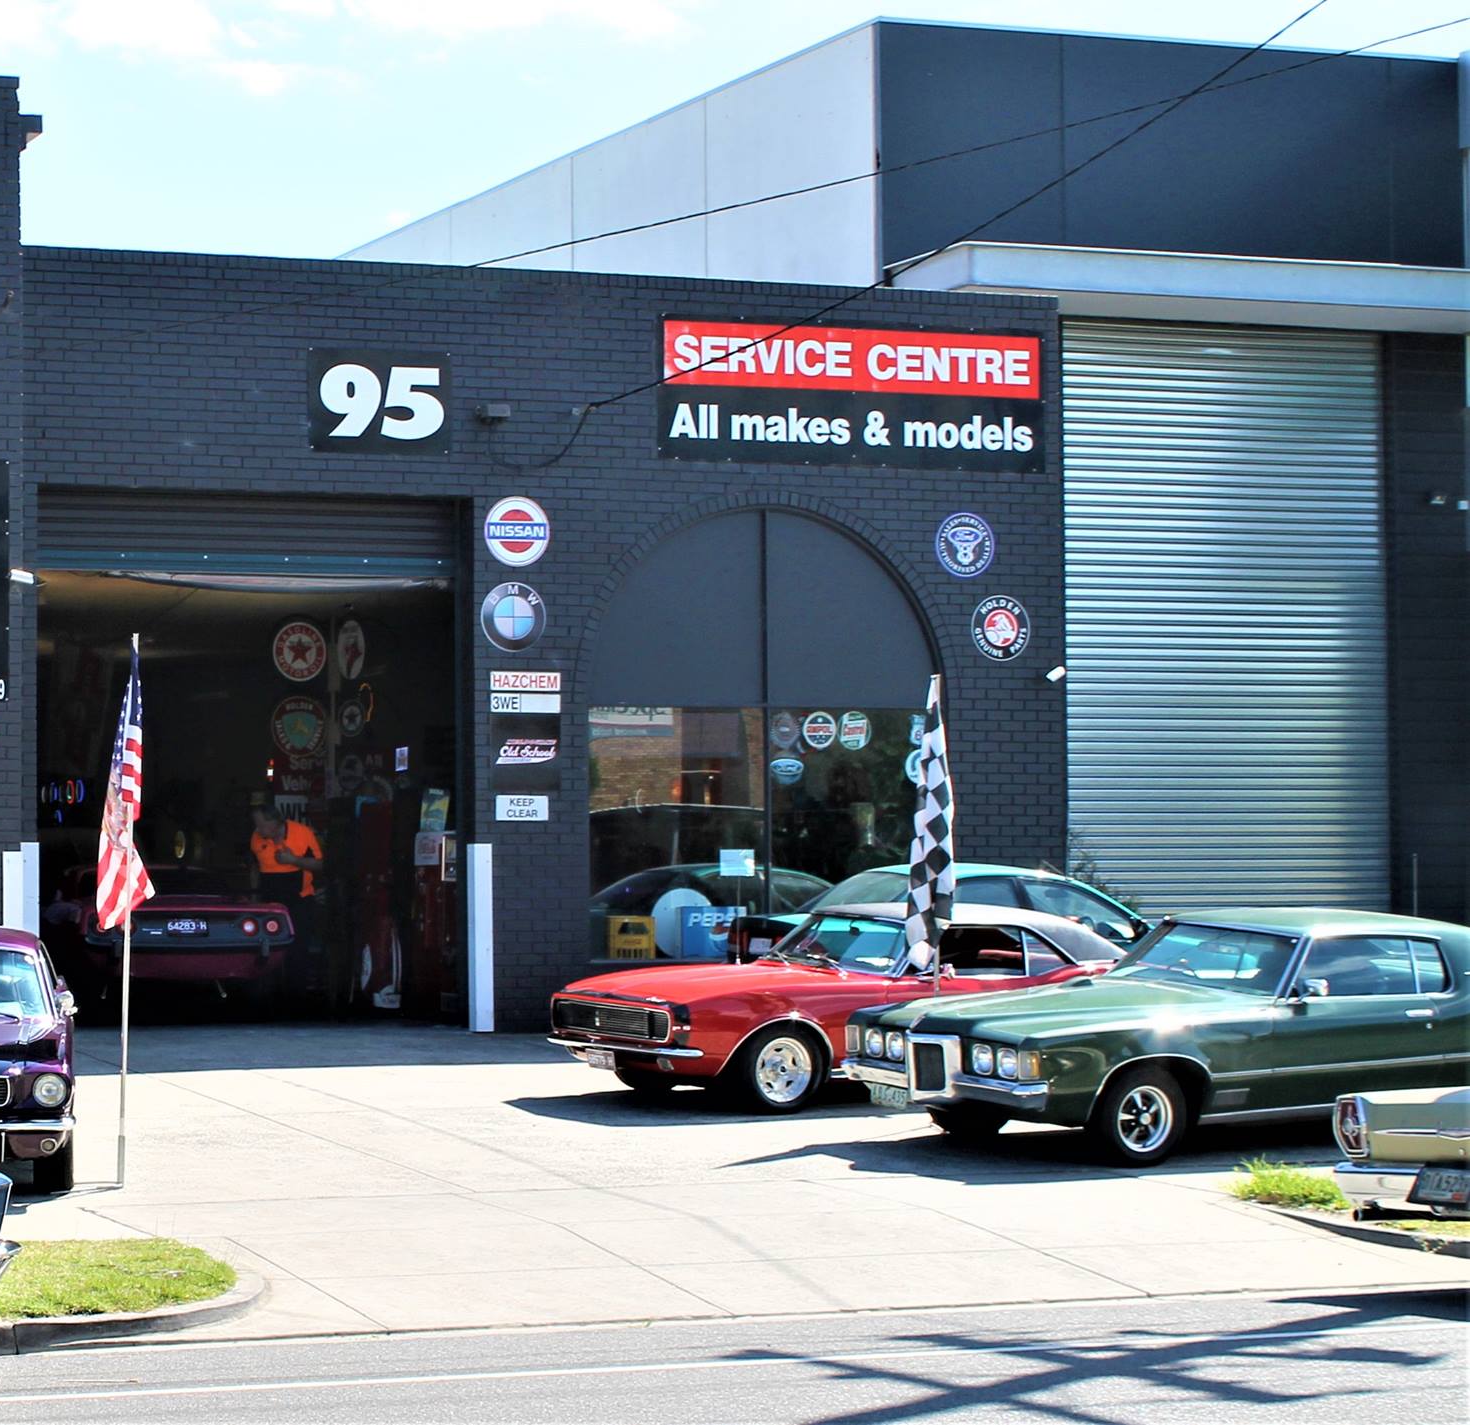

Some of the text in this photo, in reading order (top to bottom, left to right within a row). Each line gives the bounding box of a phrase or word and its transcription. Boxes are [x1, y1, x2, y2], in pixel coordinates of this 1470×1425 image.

[673, 334, 1030, 386] SERVICE CENTRE
[319, 363, 445, 440] 95
[669, 403, 1033, 453] All makes & models
[488, 525, 546, 538] NISSAN
[980, 599, 1021, 615] HOLDEN
[974, 627, 1027, 657] GENUINE PARTS
[492, 674, 558, 689] HAZCHEM
[492, 696, 519, 710] 3WE
[499, 745, 556, 758] Old School
[509, 798, 535, 807] KEEP
[506, 808, 538, 818] CLEAR
[687, 912, 736, 927] PEPS
